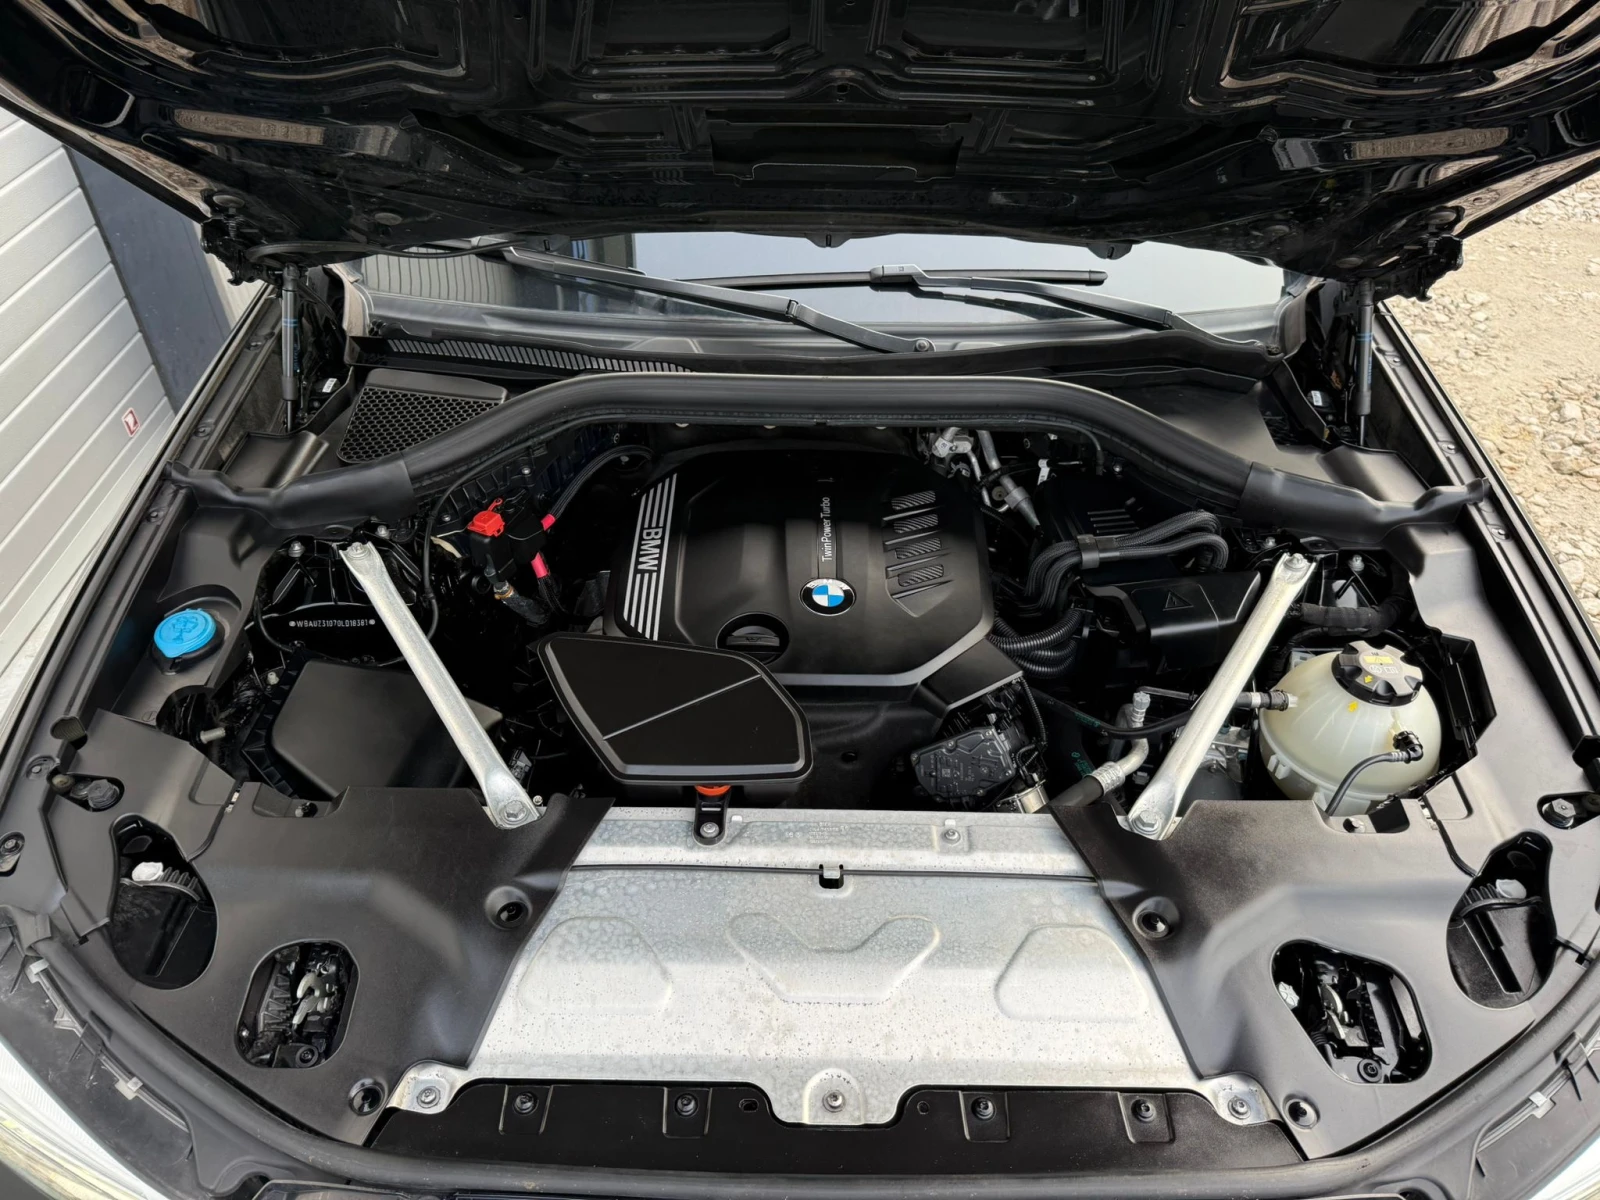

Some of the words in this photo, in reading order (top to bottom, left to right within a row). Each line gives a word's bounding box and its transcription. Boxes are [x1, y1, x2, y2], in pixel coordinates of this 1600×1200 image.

[820, 496, 831, 518] Turbo
[637, 527, 663, 571] BMW
[821, 519, 832, 562] TwinPower
